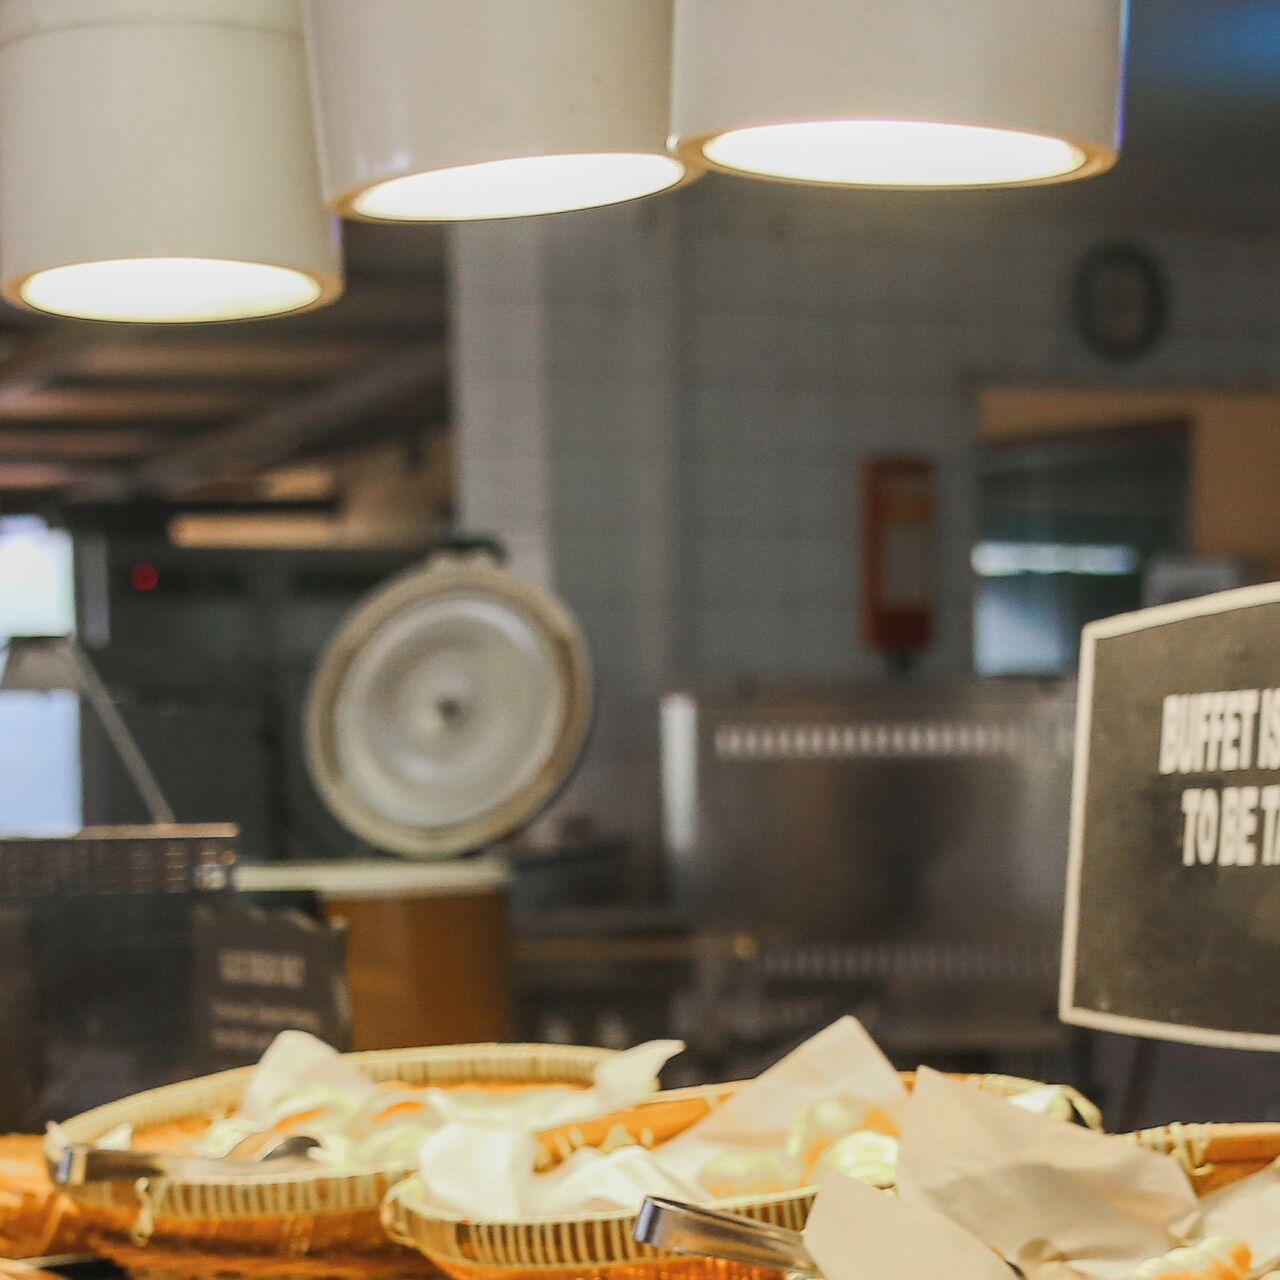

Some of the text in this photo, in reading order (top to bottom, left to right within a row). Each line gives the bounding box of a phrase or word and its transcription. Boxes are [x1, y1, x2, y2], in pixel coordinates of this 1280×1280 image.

[1158, 690, 1258, 775] BUFFET
[1181, 788, 1219, 867] TO
[1217, 786, 1260, 867] BE
